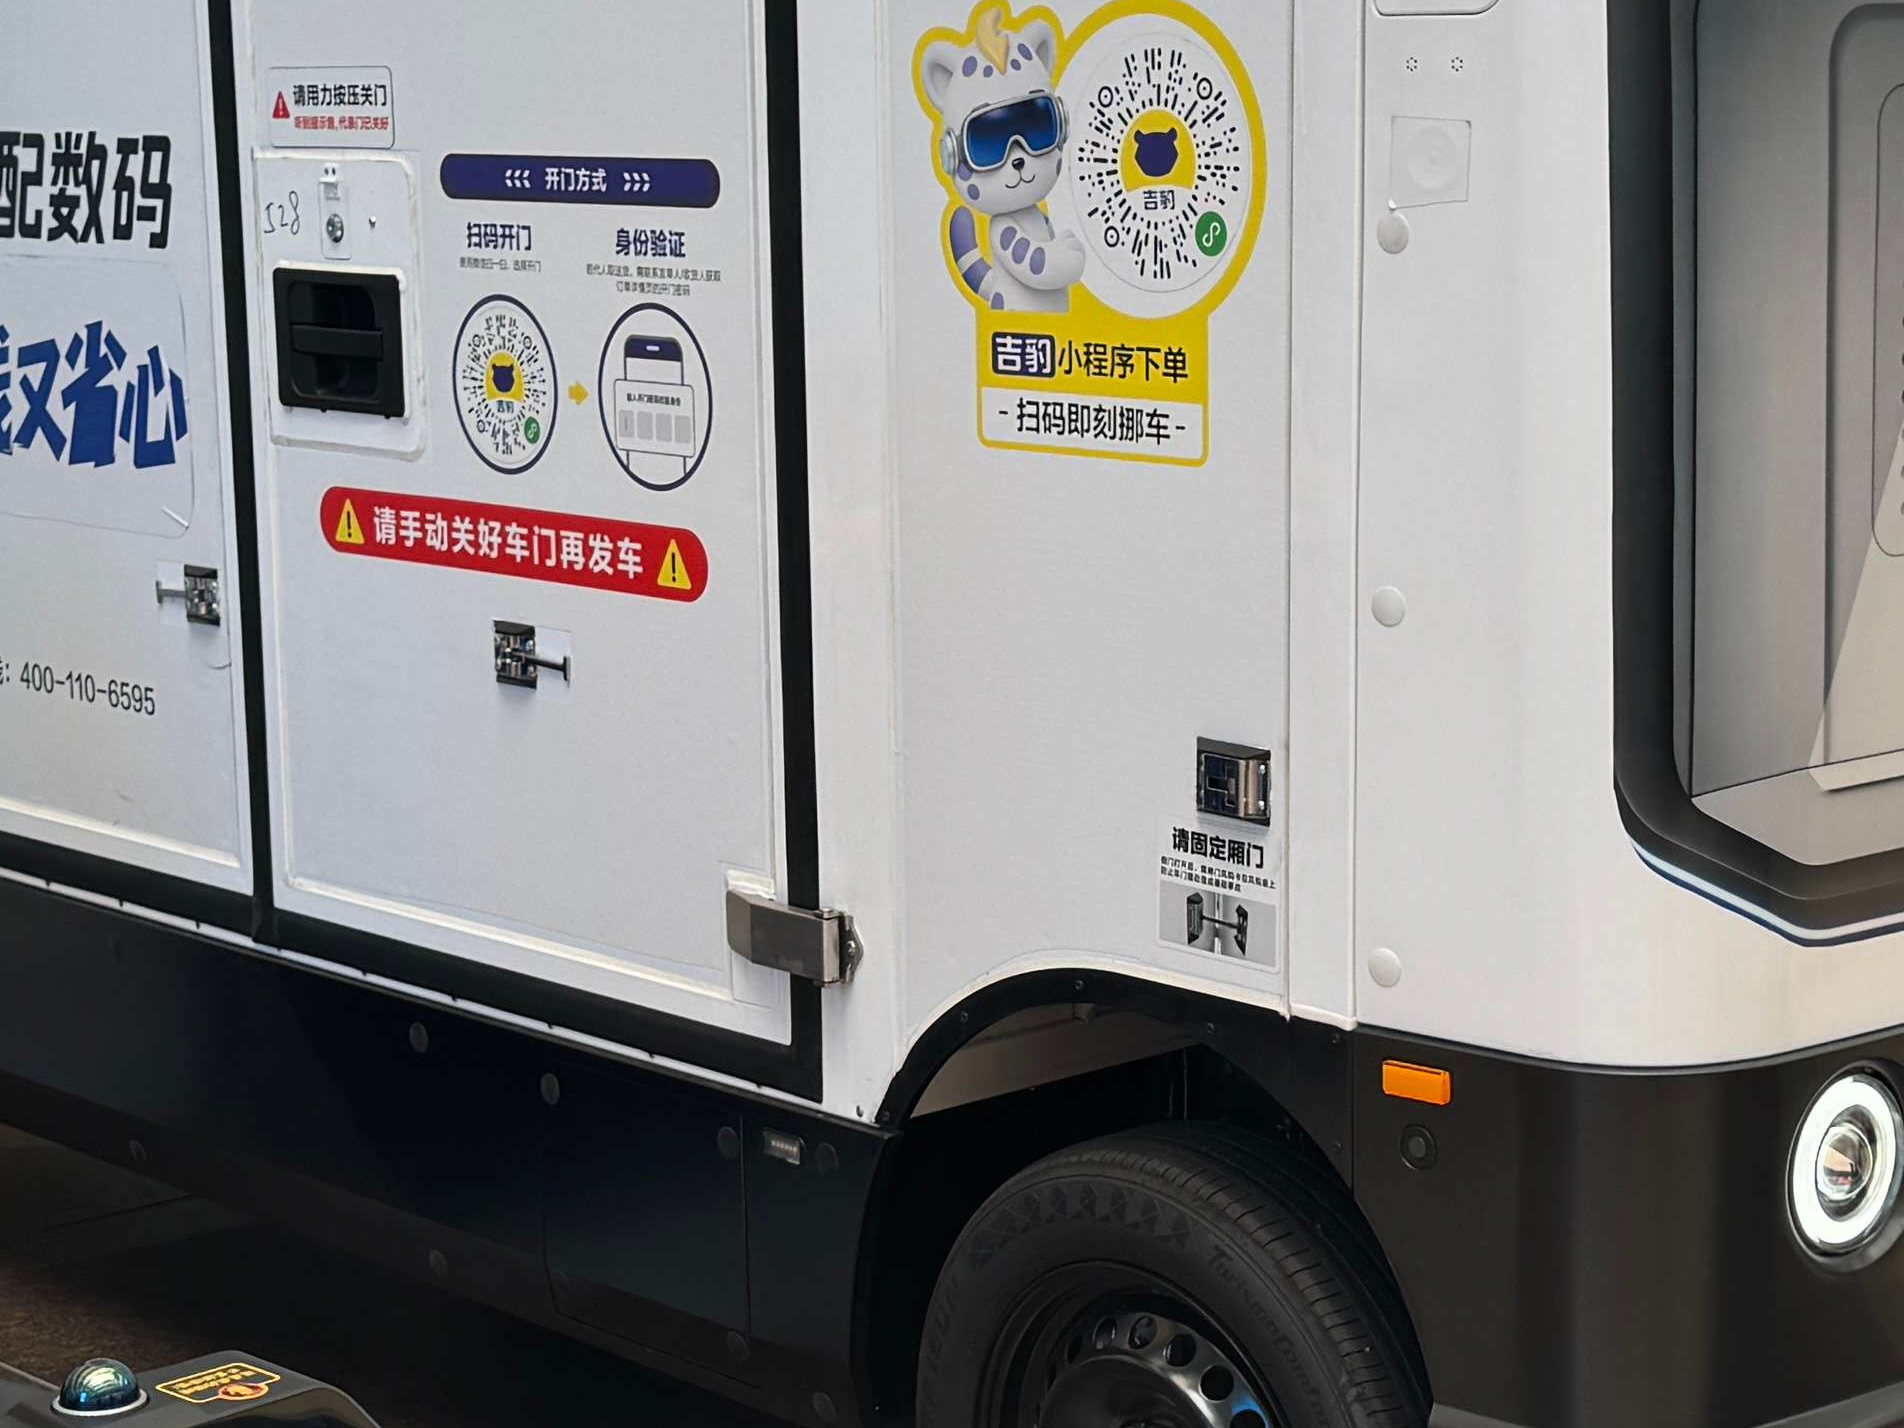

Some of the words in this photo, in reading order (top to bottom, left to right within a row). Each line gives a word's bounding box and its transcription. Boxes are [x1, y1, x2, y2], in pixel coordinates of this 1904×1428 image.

[293, 83, 387, 107] 请用力按压关门
[544, 167, 607, 195] 开门方式
[263, 190, 301, 236] 528
[1142, 189, 1176, 212] 吉豹
[467, 222, 532, 251] 扫码开门
[615, 228, 686, 258] 身份验证
[994, 334, 1189, 383] 吉豹小程序下单
[1016, 397, 1171, 446] 扫码即刻挪车
[373, 505, 644, 580] 请手动关好车门再发车
[1172, 826, 1265, 870] 请固定厢门
